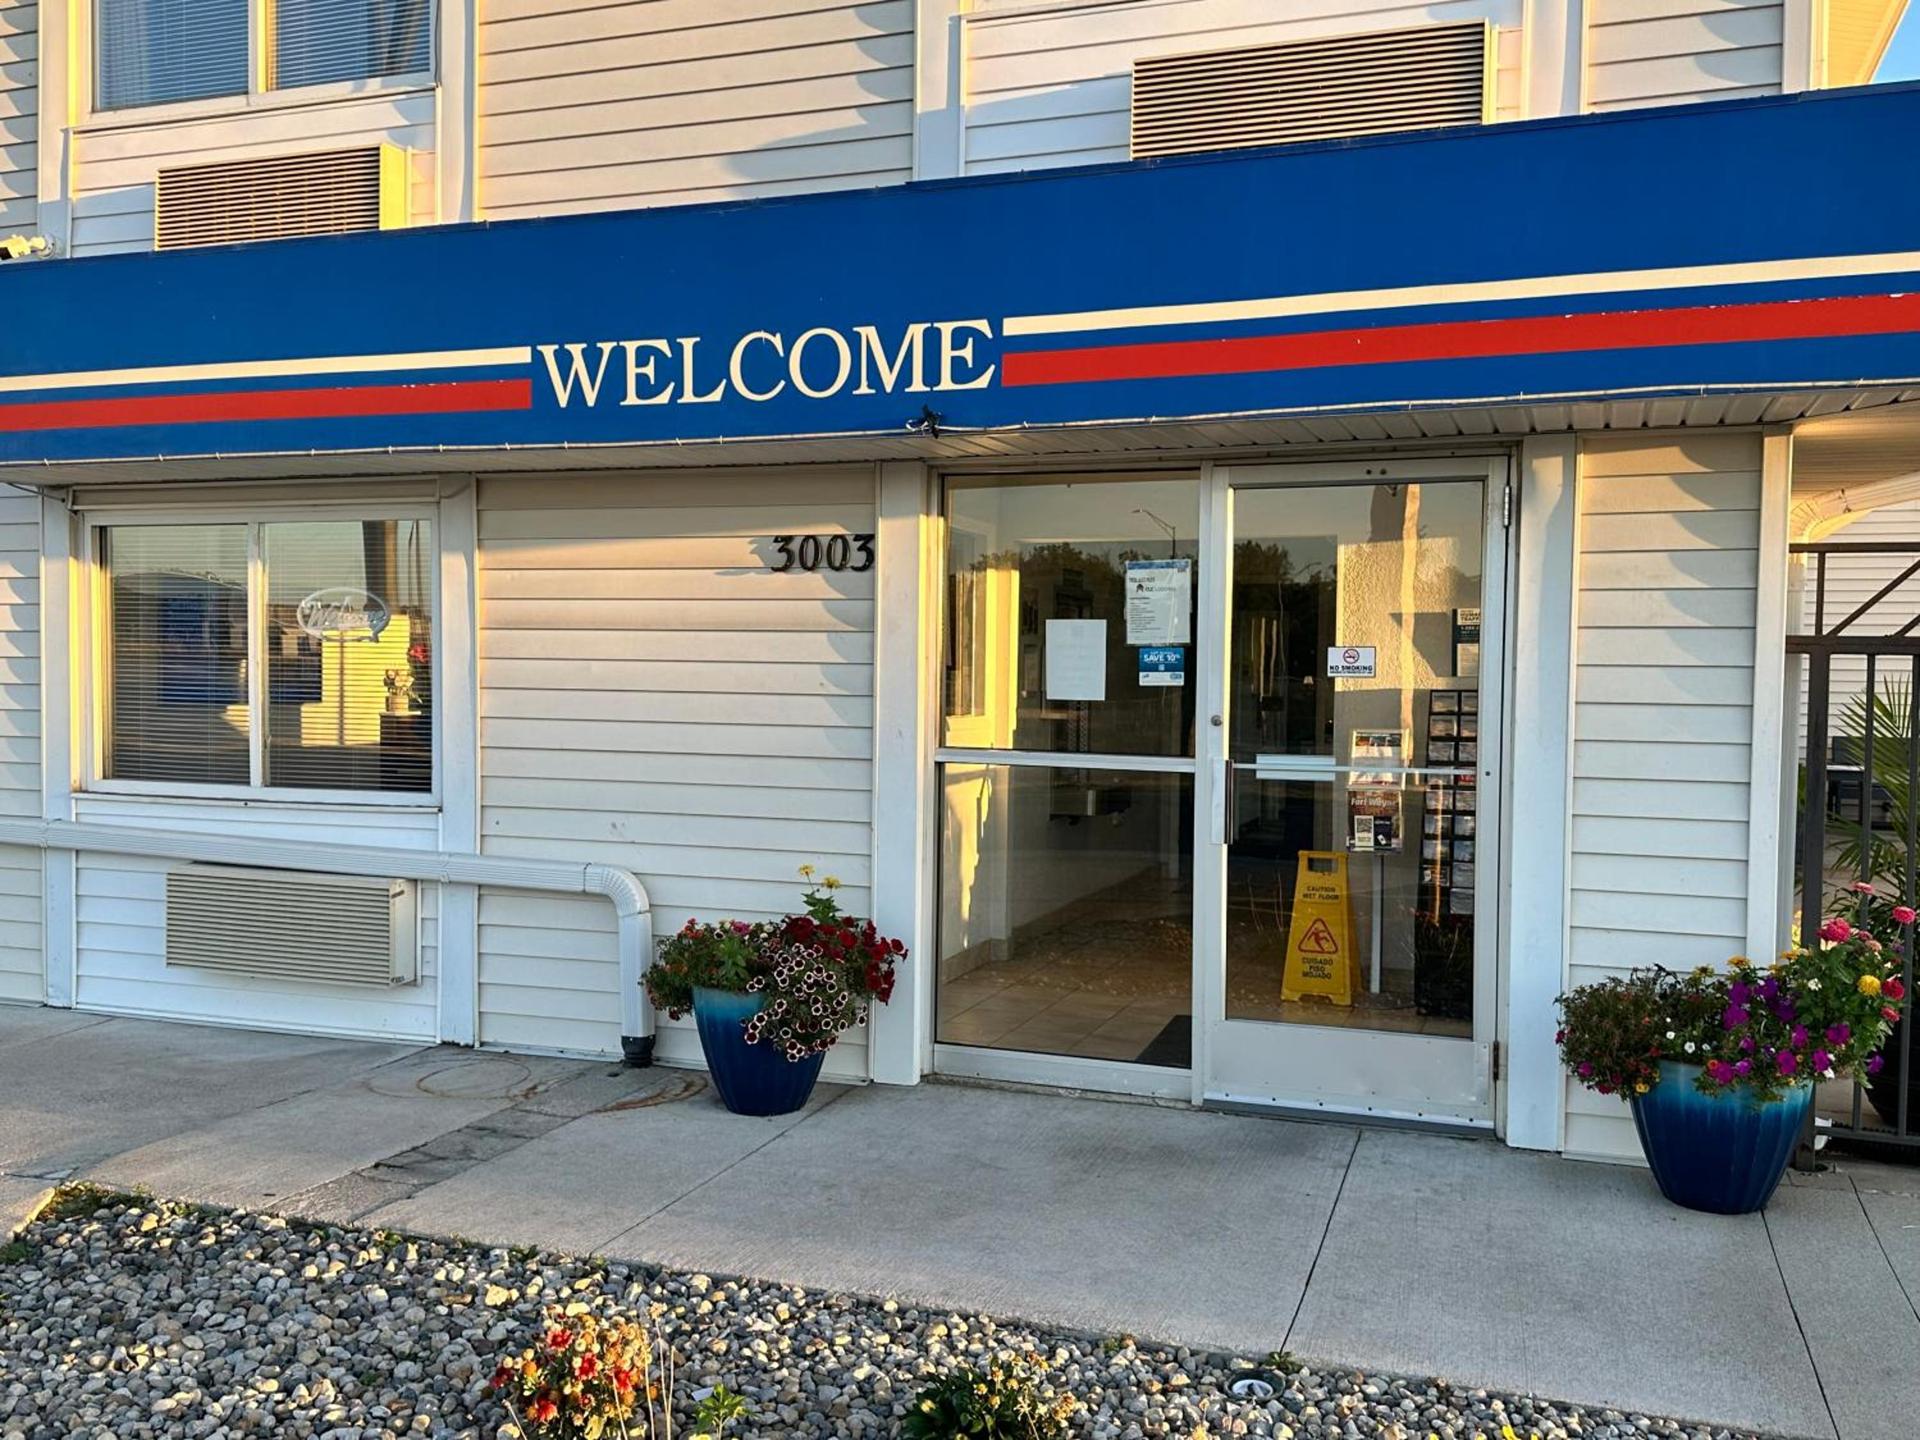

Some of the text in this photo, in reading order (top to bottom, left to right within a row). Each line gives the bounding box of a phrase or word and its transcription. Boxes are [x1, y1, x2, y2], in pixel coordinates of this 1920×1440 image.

[536, 318, 996, 408] WELCOME
[771, 533, 875, 572] 3003
[1143, 653, 1165, 662] SAVE
[1351, 798, 1367, 806] Fort
[1307, 885, 1336, 893] CAUTION
[1302, 957, 1334, 965] CUIDADO
[1302, 971, 1332, 980] MOJADO
